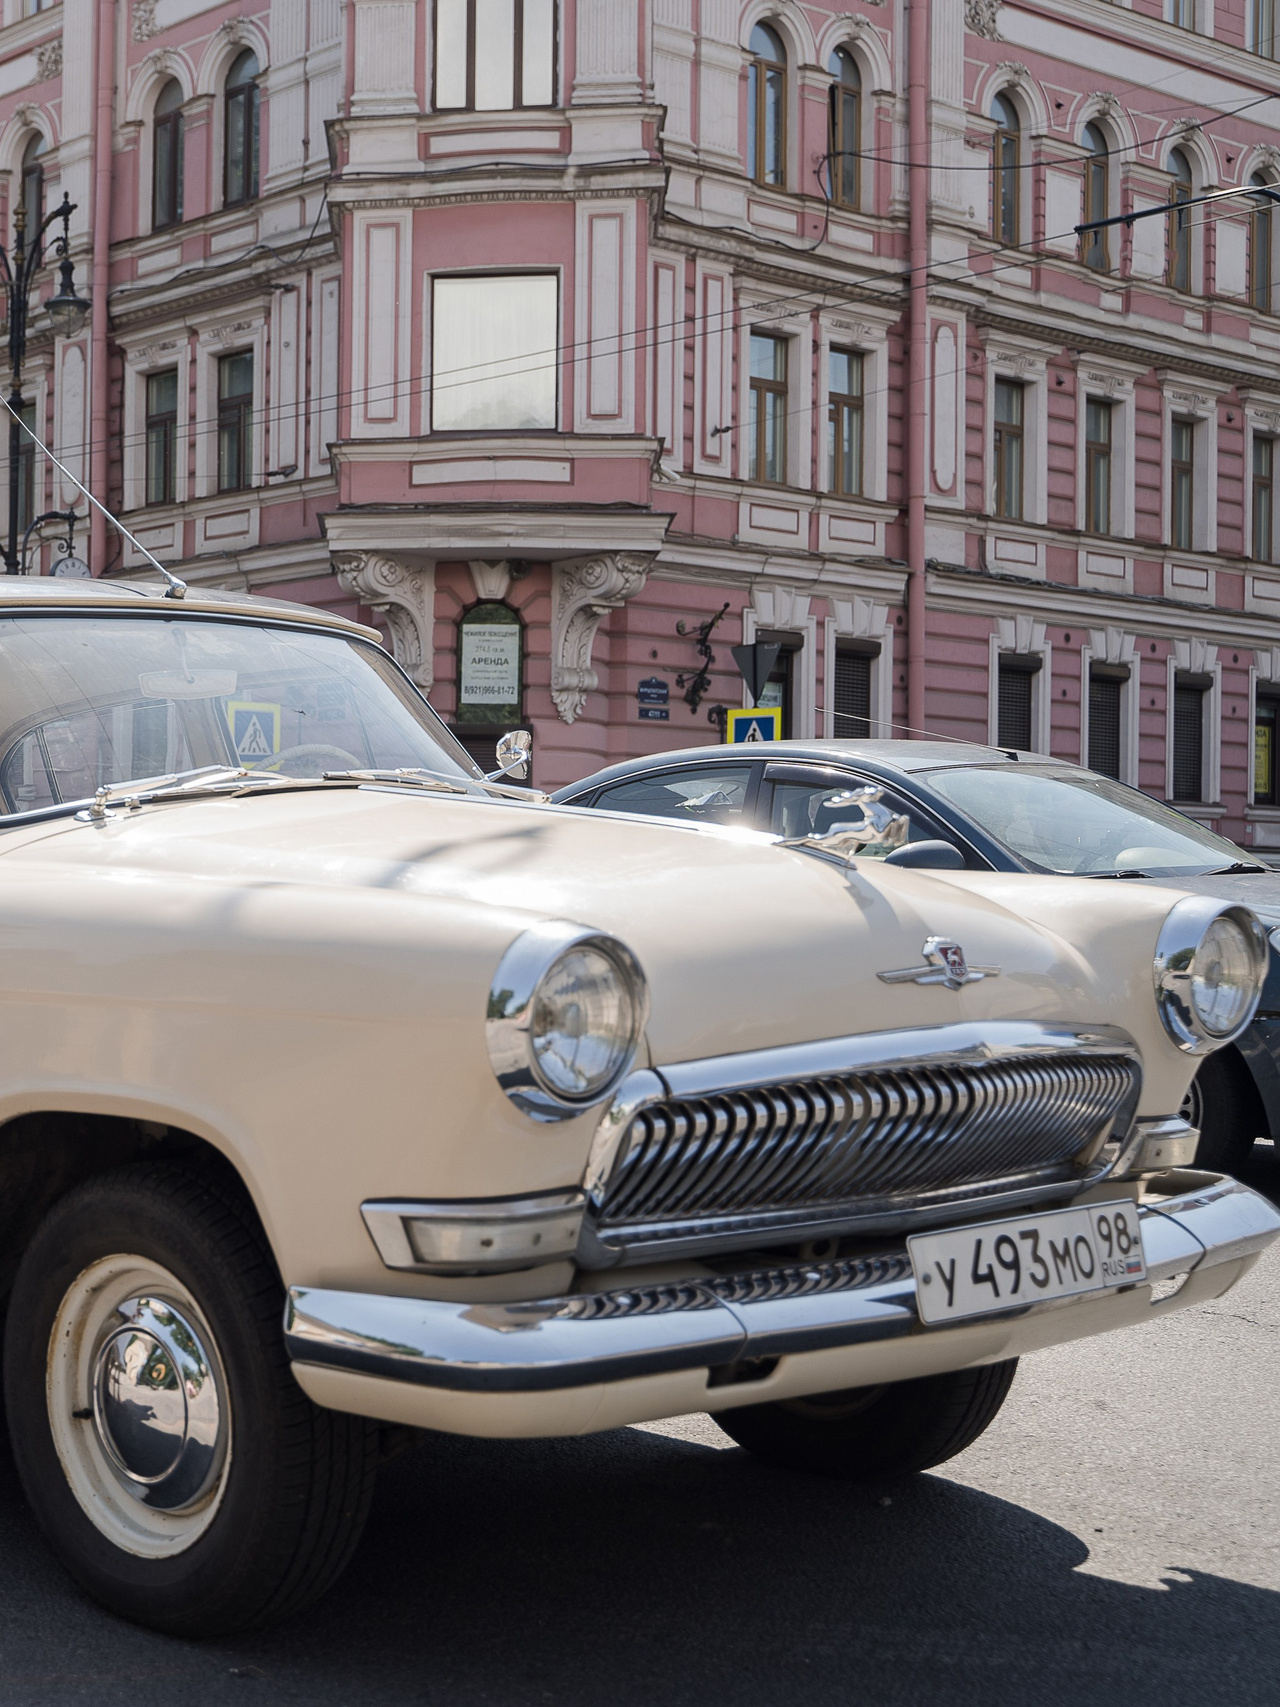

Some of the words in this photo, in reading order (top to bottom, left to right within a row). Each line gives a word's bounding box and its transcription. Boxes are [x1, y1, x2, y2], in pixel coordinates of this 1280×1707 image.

[471, 657, 509, 666] АРЕНДА
[1097, 1211, 1131, 1258] 98
[1102, 1260, 1126, 1278] RUS
